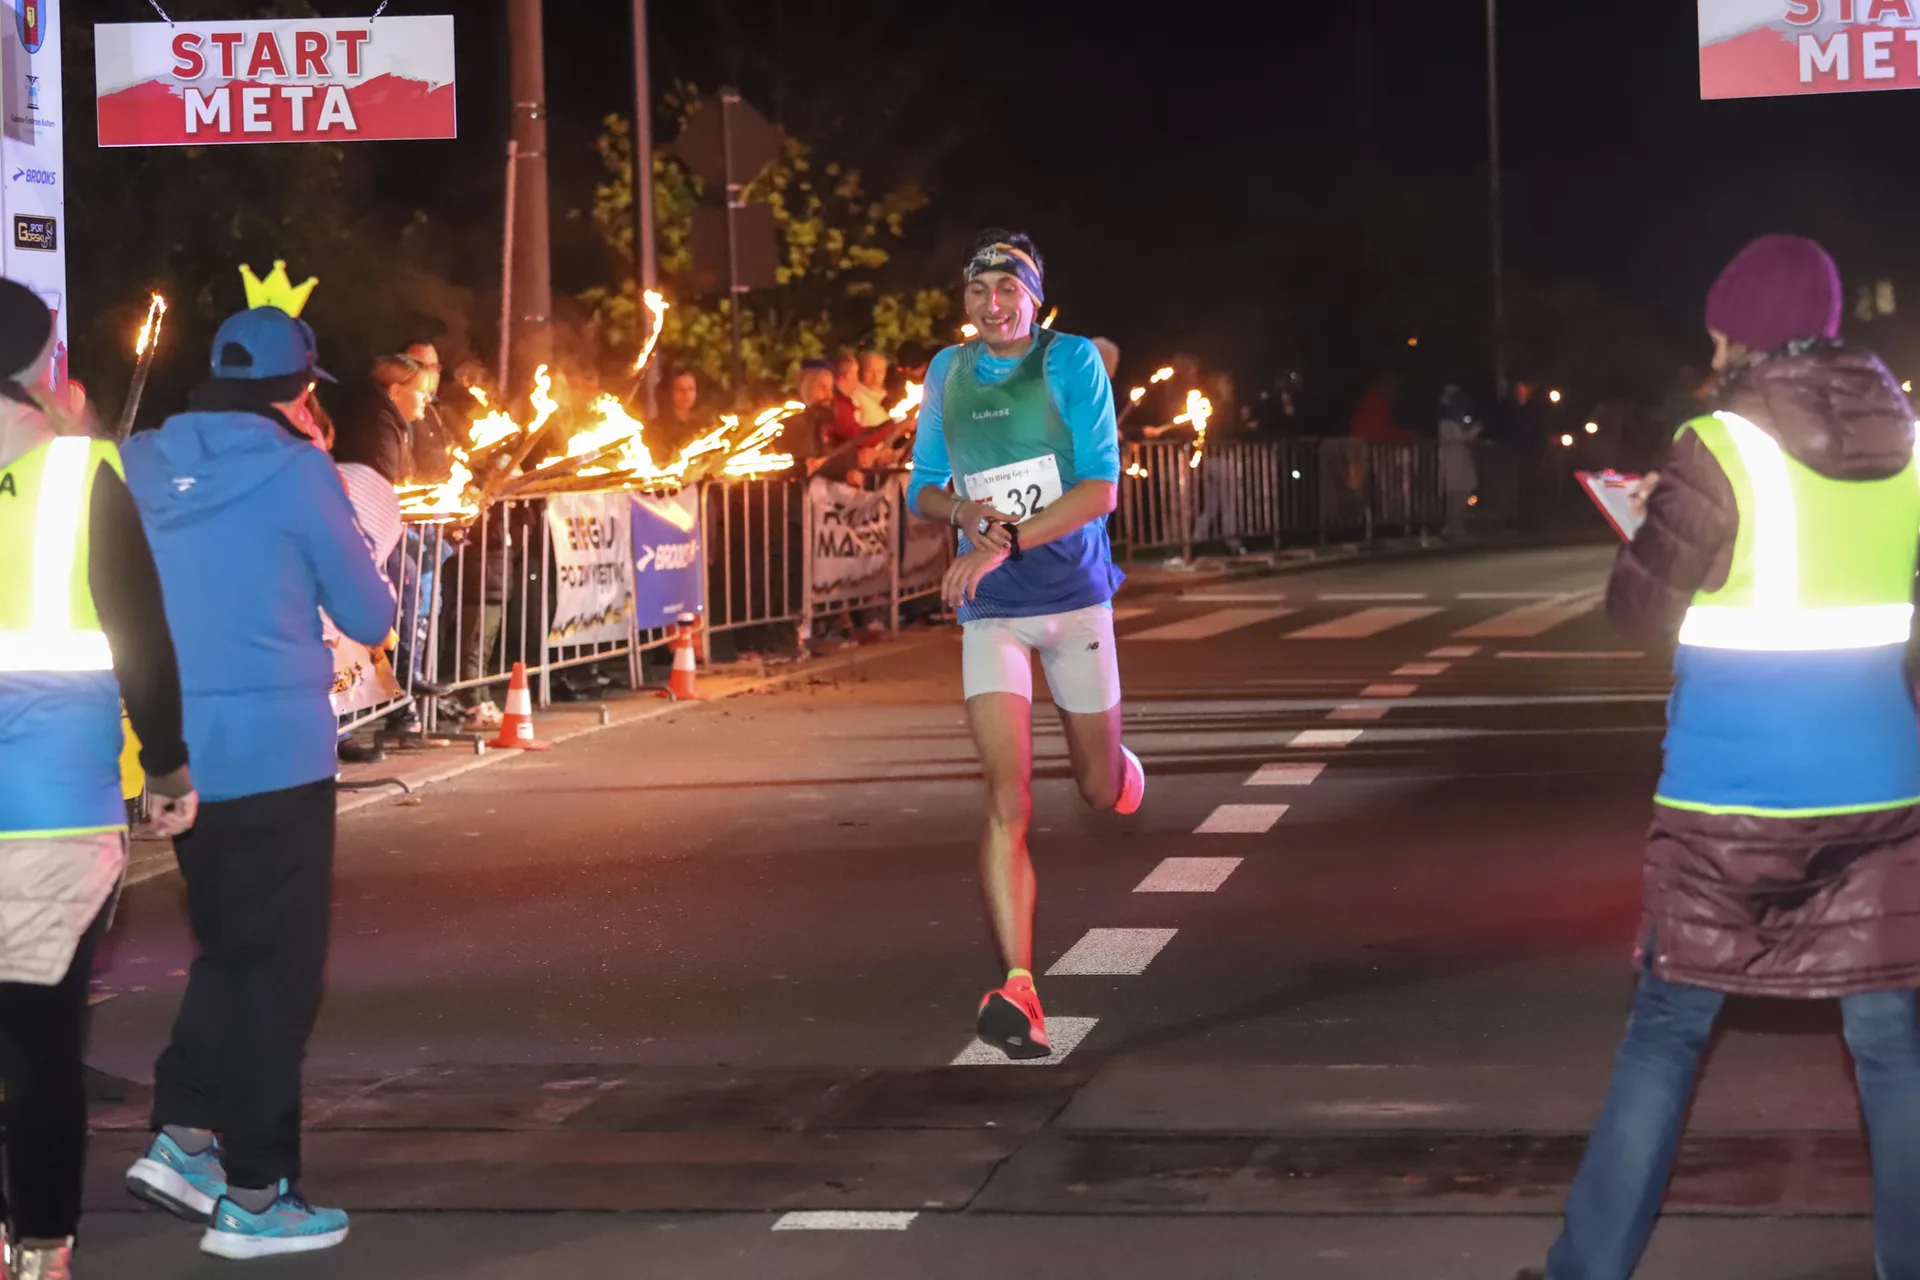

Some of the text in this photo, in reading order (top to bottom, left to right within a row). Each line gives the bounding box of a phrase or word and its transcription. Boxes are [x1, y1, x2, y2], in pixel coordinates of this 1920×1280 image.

[171, 29, 369, 80] START
[184, 85, 357, 133] META
[26, 168, 56, 185] BROOKS
[30, 223, 44, 233] SPORT
[1007, 483, 1044, 518] 32
